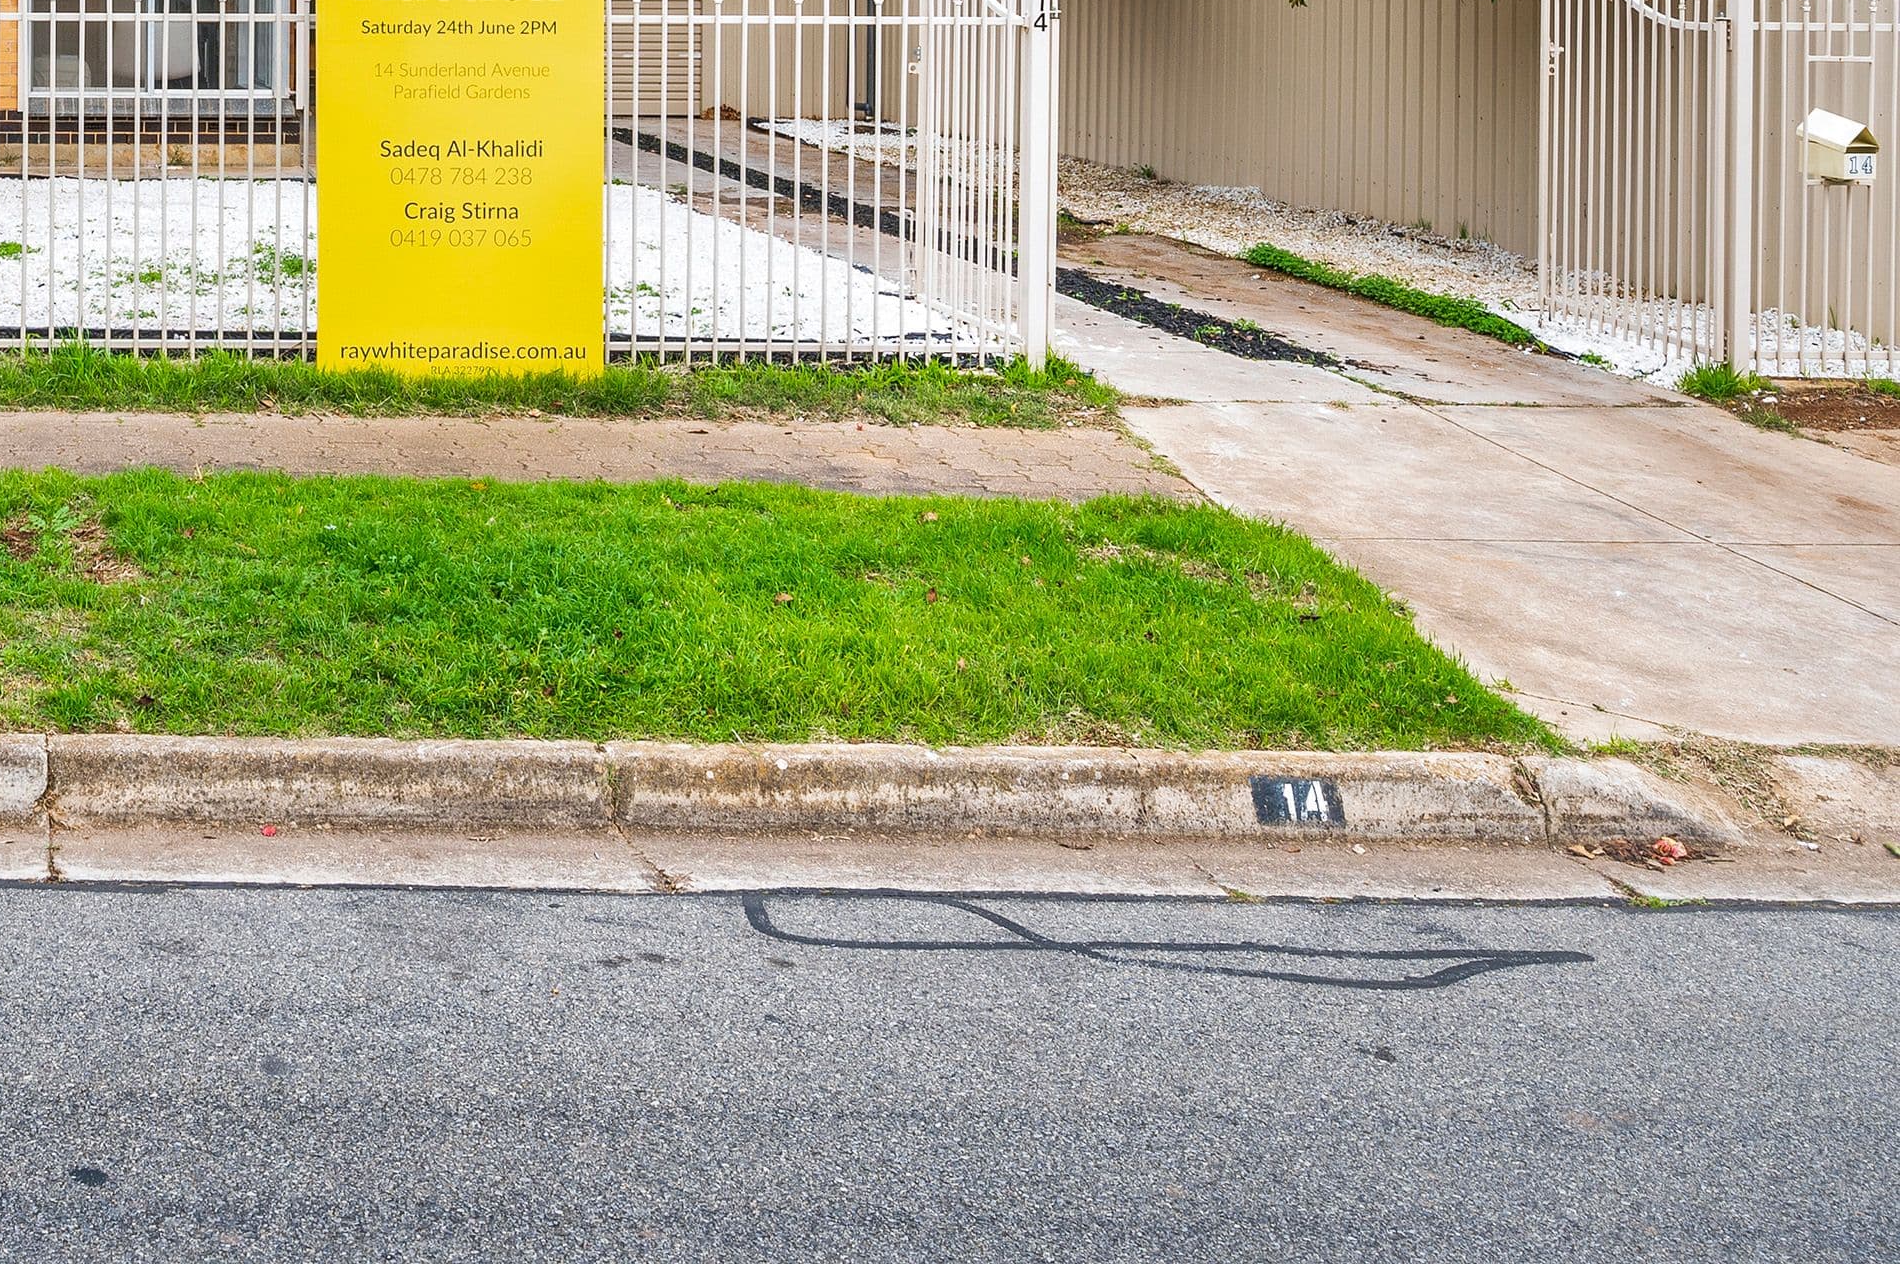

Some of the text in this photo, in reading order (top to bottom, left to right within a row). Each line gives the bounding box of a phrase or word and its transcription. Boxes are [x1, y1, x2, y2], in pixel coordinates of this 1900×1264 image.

[361, 19, 557, 37] Saturday 24th June 2PM
[374, 62, 550, 78] 14 Sunderland Avenue
[393, 84, 531, 99] Parafield Gardens
[380, 140, 543, 161] Sadeq Al-Khalidi
[1849, 156, 1873, 175] 14
[390, 167, 532, 185] 0478 784 238
[404, 202, 519, 223] Craig Stirna
[390, 229, 532, 247] 0419 037 065
[340, 341, 586, 362] raywhiteparadise.com.au
[431, 365, 451, 375] RLA
[1283, 780, 1329, 822] 14
